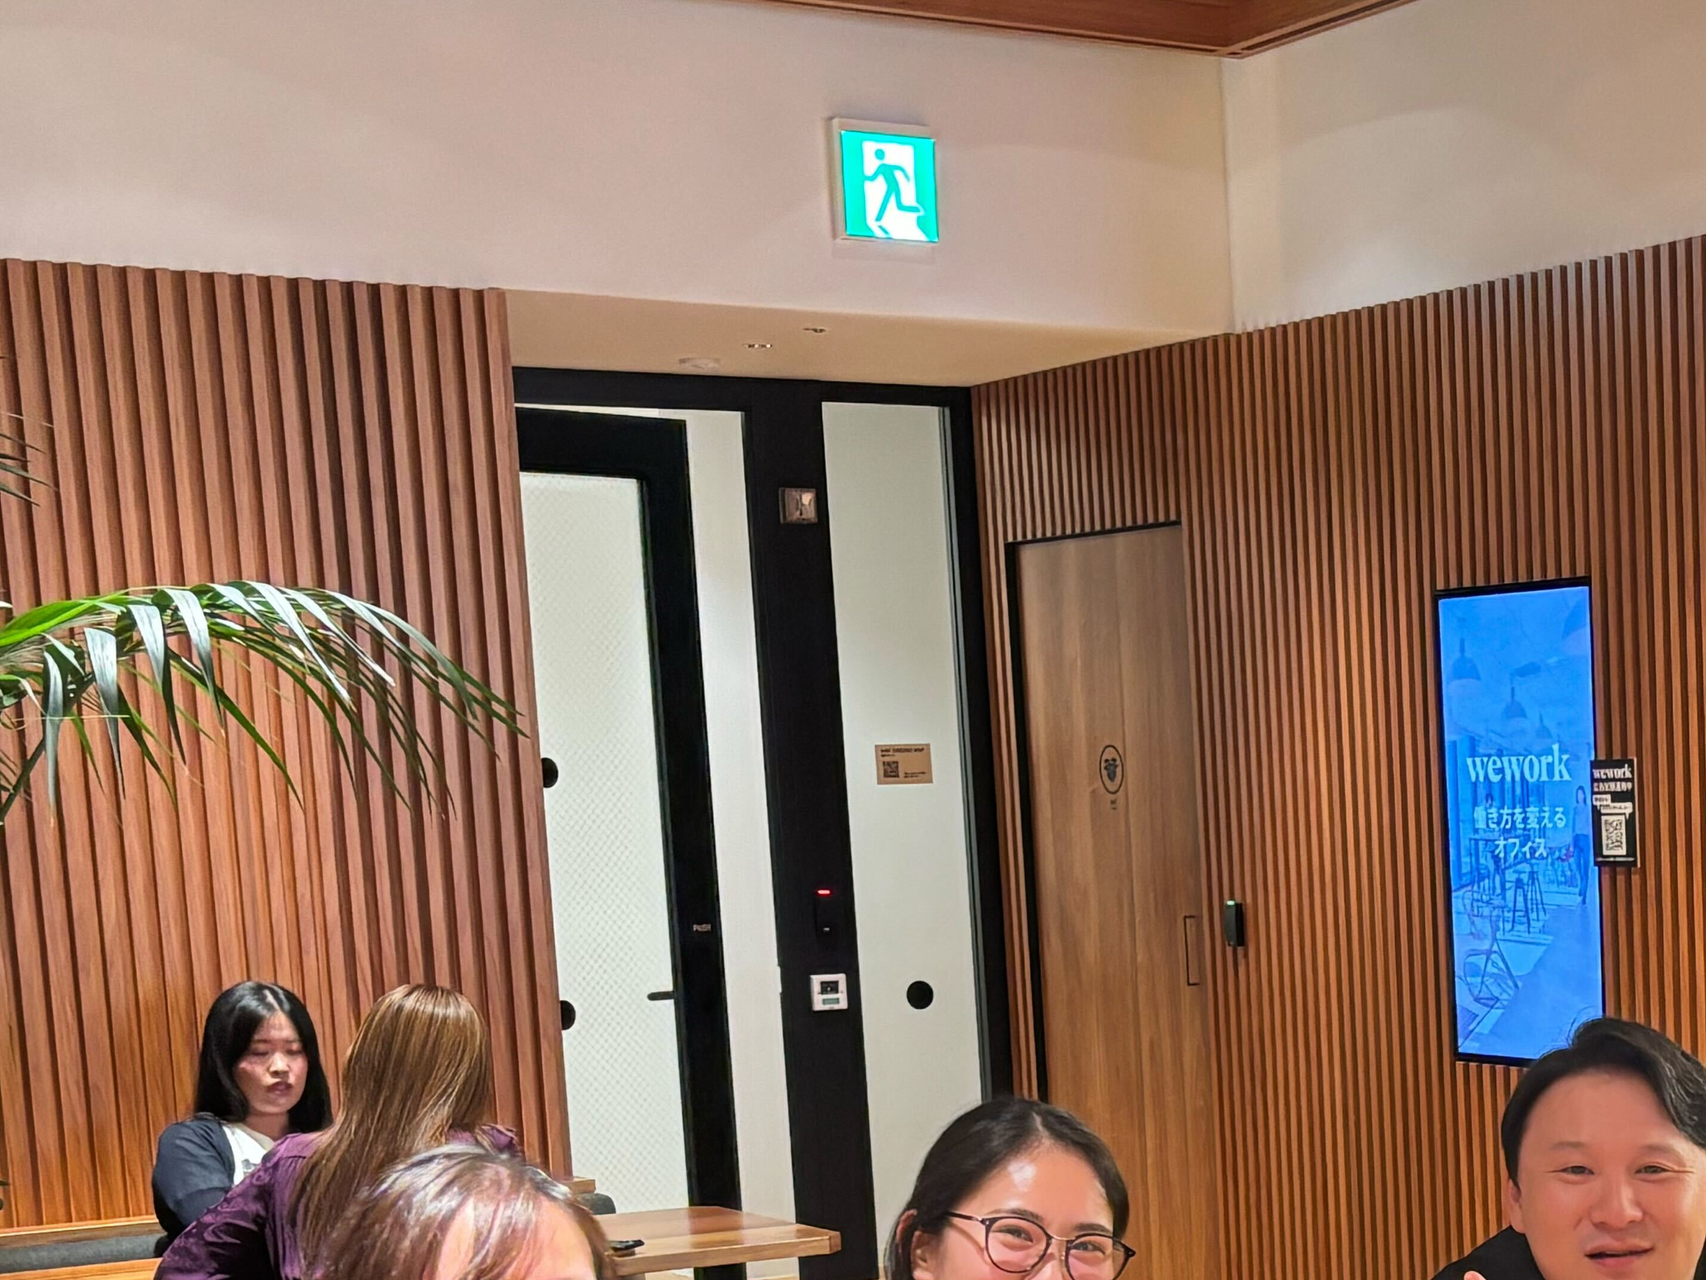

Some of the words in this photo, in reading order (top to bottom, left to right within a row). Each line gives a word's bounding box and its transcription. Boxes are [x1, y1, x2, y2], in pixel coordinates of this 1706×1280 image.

[1466, 743, 1571, 782] wework
[1592, 764, 1632, 779] wework
[1495, 836, 1548, 859] オフィス
